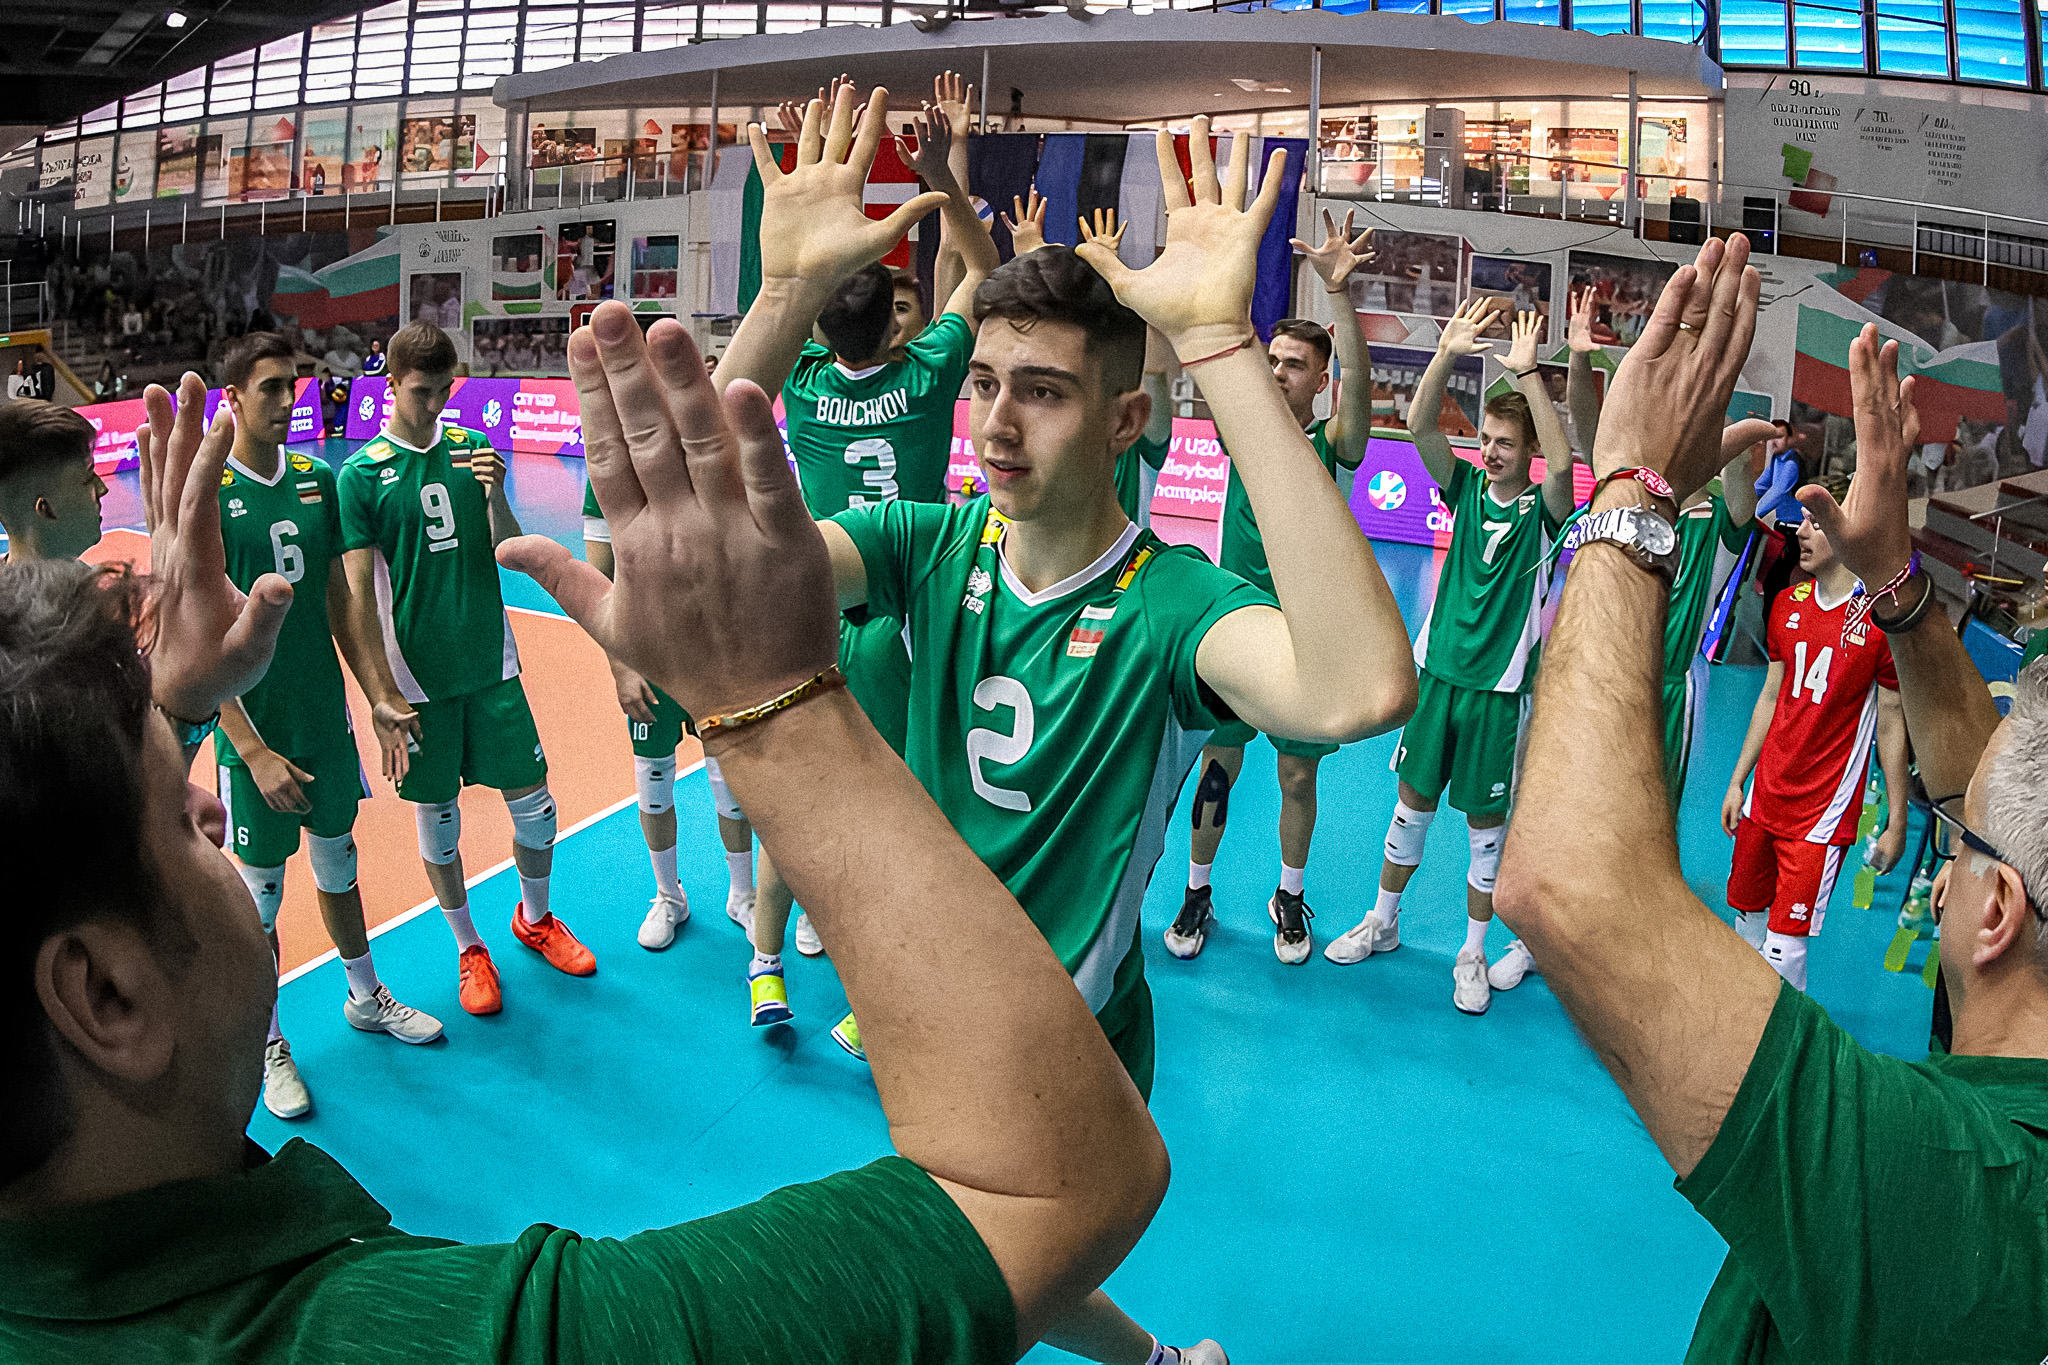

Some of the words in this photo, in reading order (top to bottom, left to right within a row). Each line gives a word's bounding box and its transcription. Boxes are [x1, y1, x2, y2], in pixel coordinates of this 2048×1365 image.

[1185, 437, 1221, 457] U20
[844, 438, 899, 509] 3
[419, 482, 456, 541] 9
[1426, 511, 1455, 533] Ch
[269, 519, 305, 585] 6
[1481, 520, 1512, 565] 7
[1791, 641, 1834, 705] 14
[633, 722, 649, 741] 10
[966, 675, 1035, 812] 2
[237, 826, 249, 846] 6
